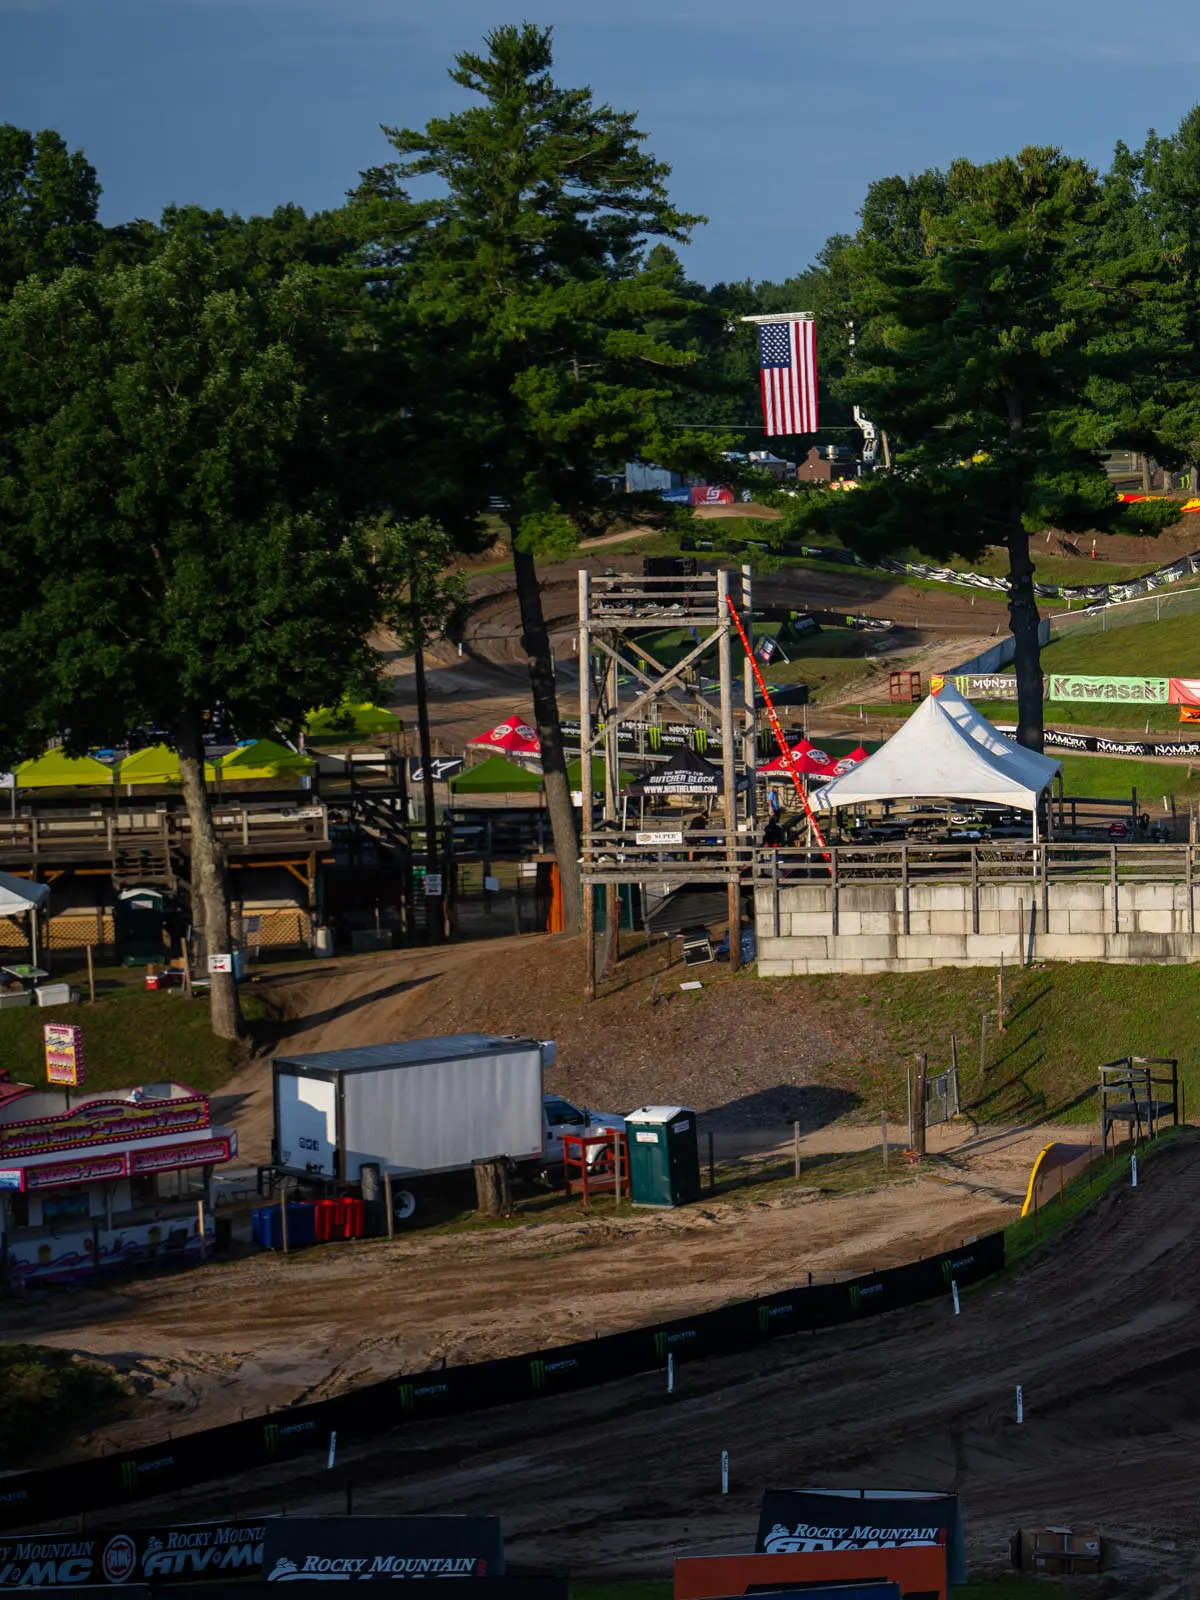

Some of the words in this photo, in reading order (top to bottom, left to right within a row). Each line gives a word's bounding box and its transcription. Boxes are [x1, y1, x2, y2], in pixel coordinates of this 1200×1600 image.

[973, 679, 1017, 690] MONST
[1054, 677, 1165, 700] Kawasaki
[1044, 732, 1087, 746] NAMURA
[1097, 742, 1144, 753] NAMURA
[166, 1531, 212, 1548] ROCKY
[792, 1523, 849, 1539] ROCKY
[850, 1525, 939, 1540] MOUNTAIN
[14, 1540, 97, 1560] MOUNTAIN
[300, 1555, 368, 1573] ROCKY
[369, 1555, 477, 1573] MOUNTAIN
